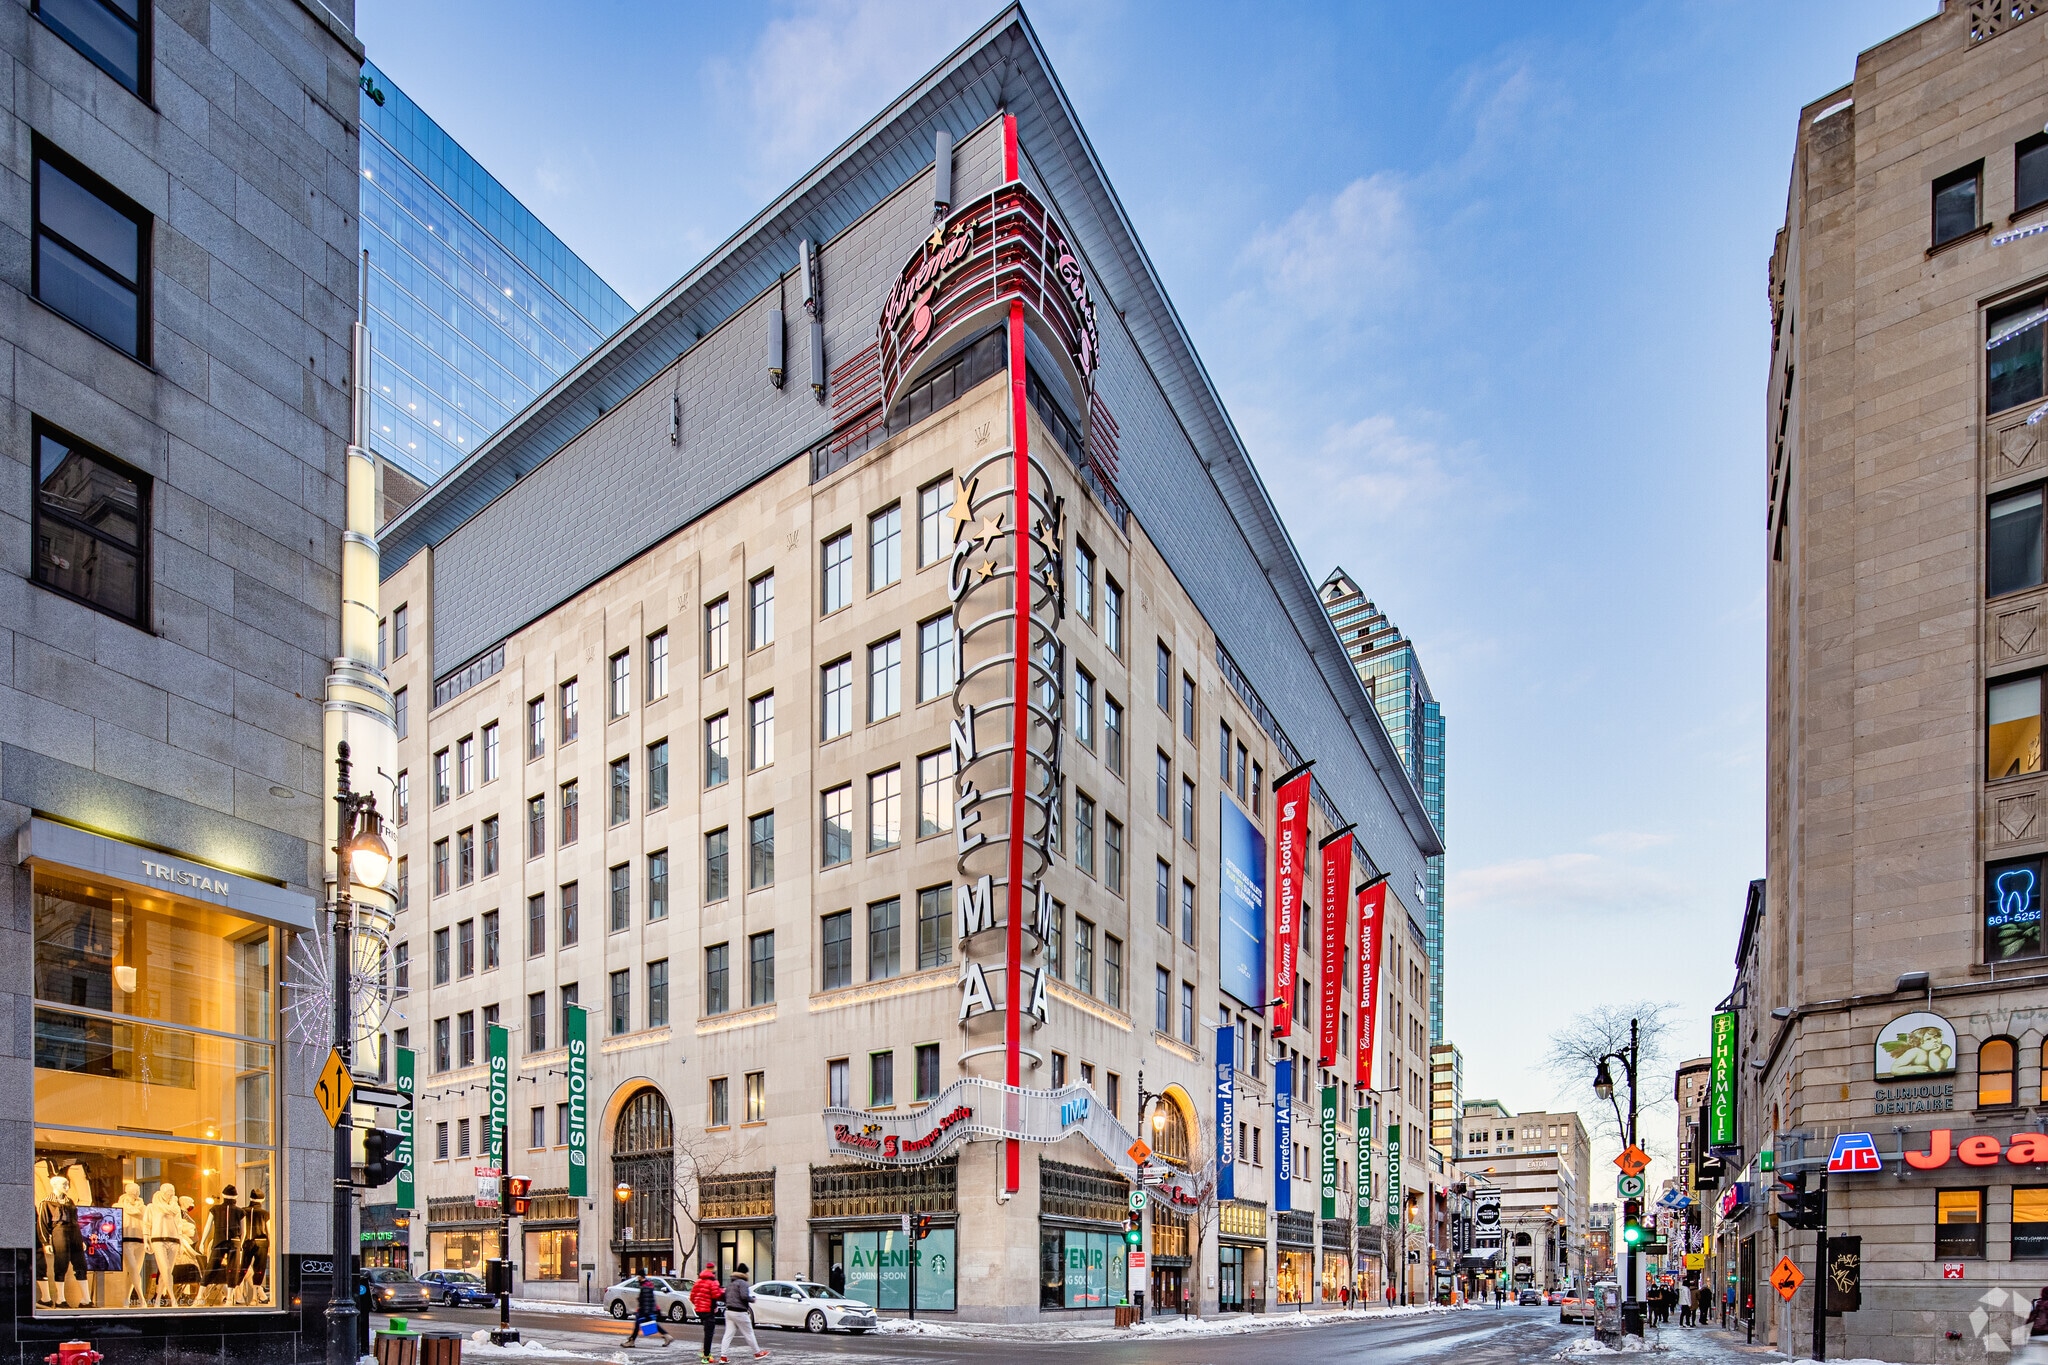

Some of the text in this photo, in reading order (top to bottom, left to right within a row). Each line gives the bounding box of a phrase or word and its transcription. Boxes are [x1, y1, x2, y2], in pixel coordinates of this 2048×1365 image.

[142, 860, 228, 897] TRISTAN
[1278, 829, 1293, 988] Cinéma Banque Scotia
[1988, 910, 2041, 925] 861-5252
[1325, 859, 1335, 1044] CINEPLEX DIVERTISSEMENT
[1359, 925, 1372, 1051] Cinéma Banque Scotia
[492, 1055, 507, 1157] simons
[570, 1039, 585, 1147] simons
[1715, 1033, 1729, 1141] PHARMACIE
[1874, 1098, 1954, 1115] DENTAIRE
[1875, 1084, 1954, 1101] CLINIQUE
[902, 1131, 942, 1152] Banque
[938, 1105, 974, 1132] Scotia
[1221, 1102, 1232, 1165] Carrefour
[1280, 1126, 1290, 1181] Carrefour
[1323, 1107, 1335, 1184] simons
[1358, 1126, 1370, 1194] simons
[1388, 1141, 1399, 1208] simons
[851, 1246, 922, 1267] À VENIR
[882, 1272, 906, 1280] SOON
